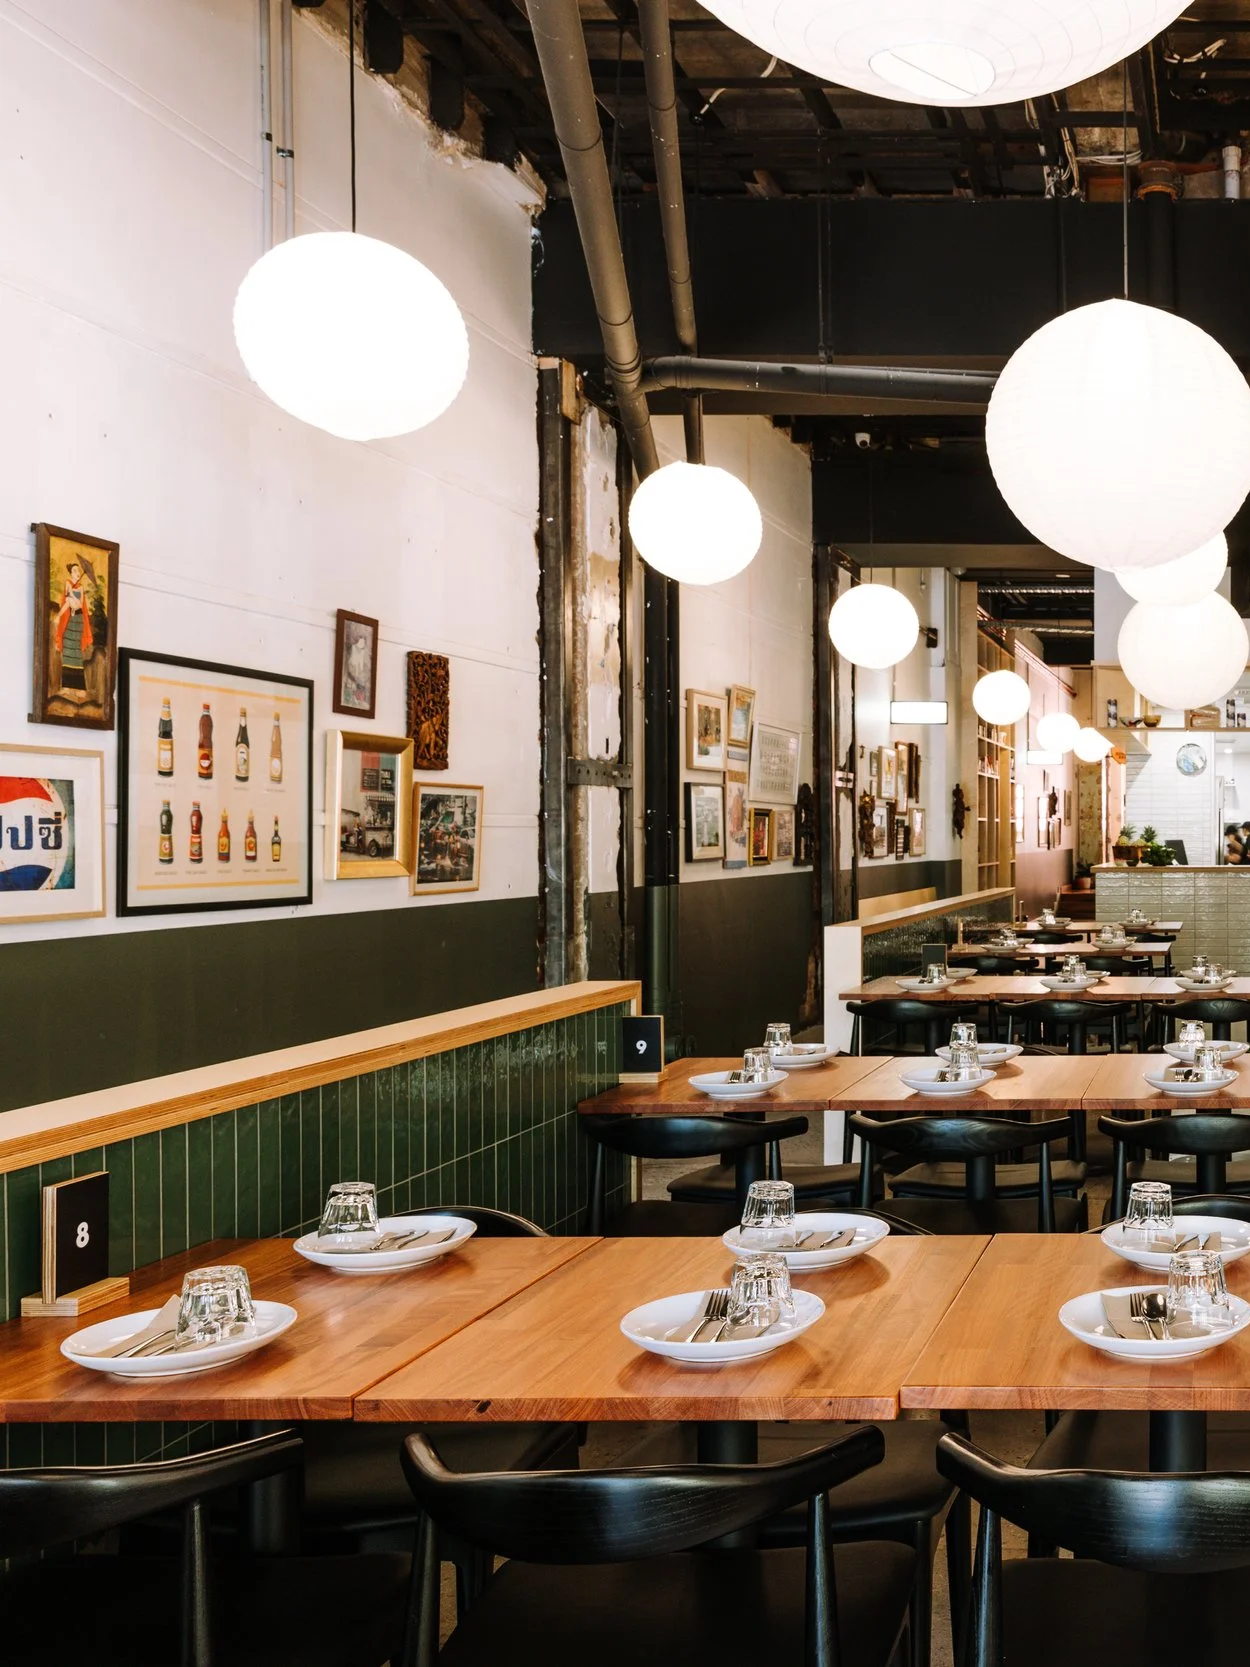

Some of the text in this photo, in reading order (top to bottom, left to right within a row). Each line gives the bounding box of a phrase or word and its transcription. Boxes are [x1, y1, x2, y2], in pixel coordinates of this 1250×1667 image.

[0, 811, 63, 851] ปซี่
[636, 1040, 647, 1054] 9
[76, 1221, 90, 1248] 8
